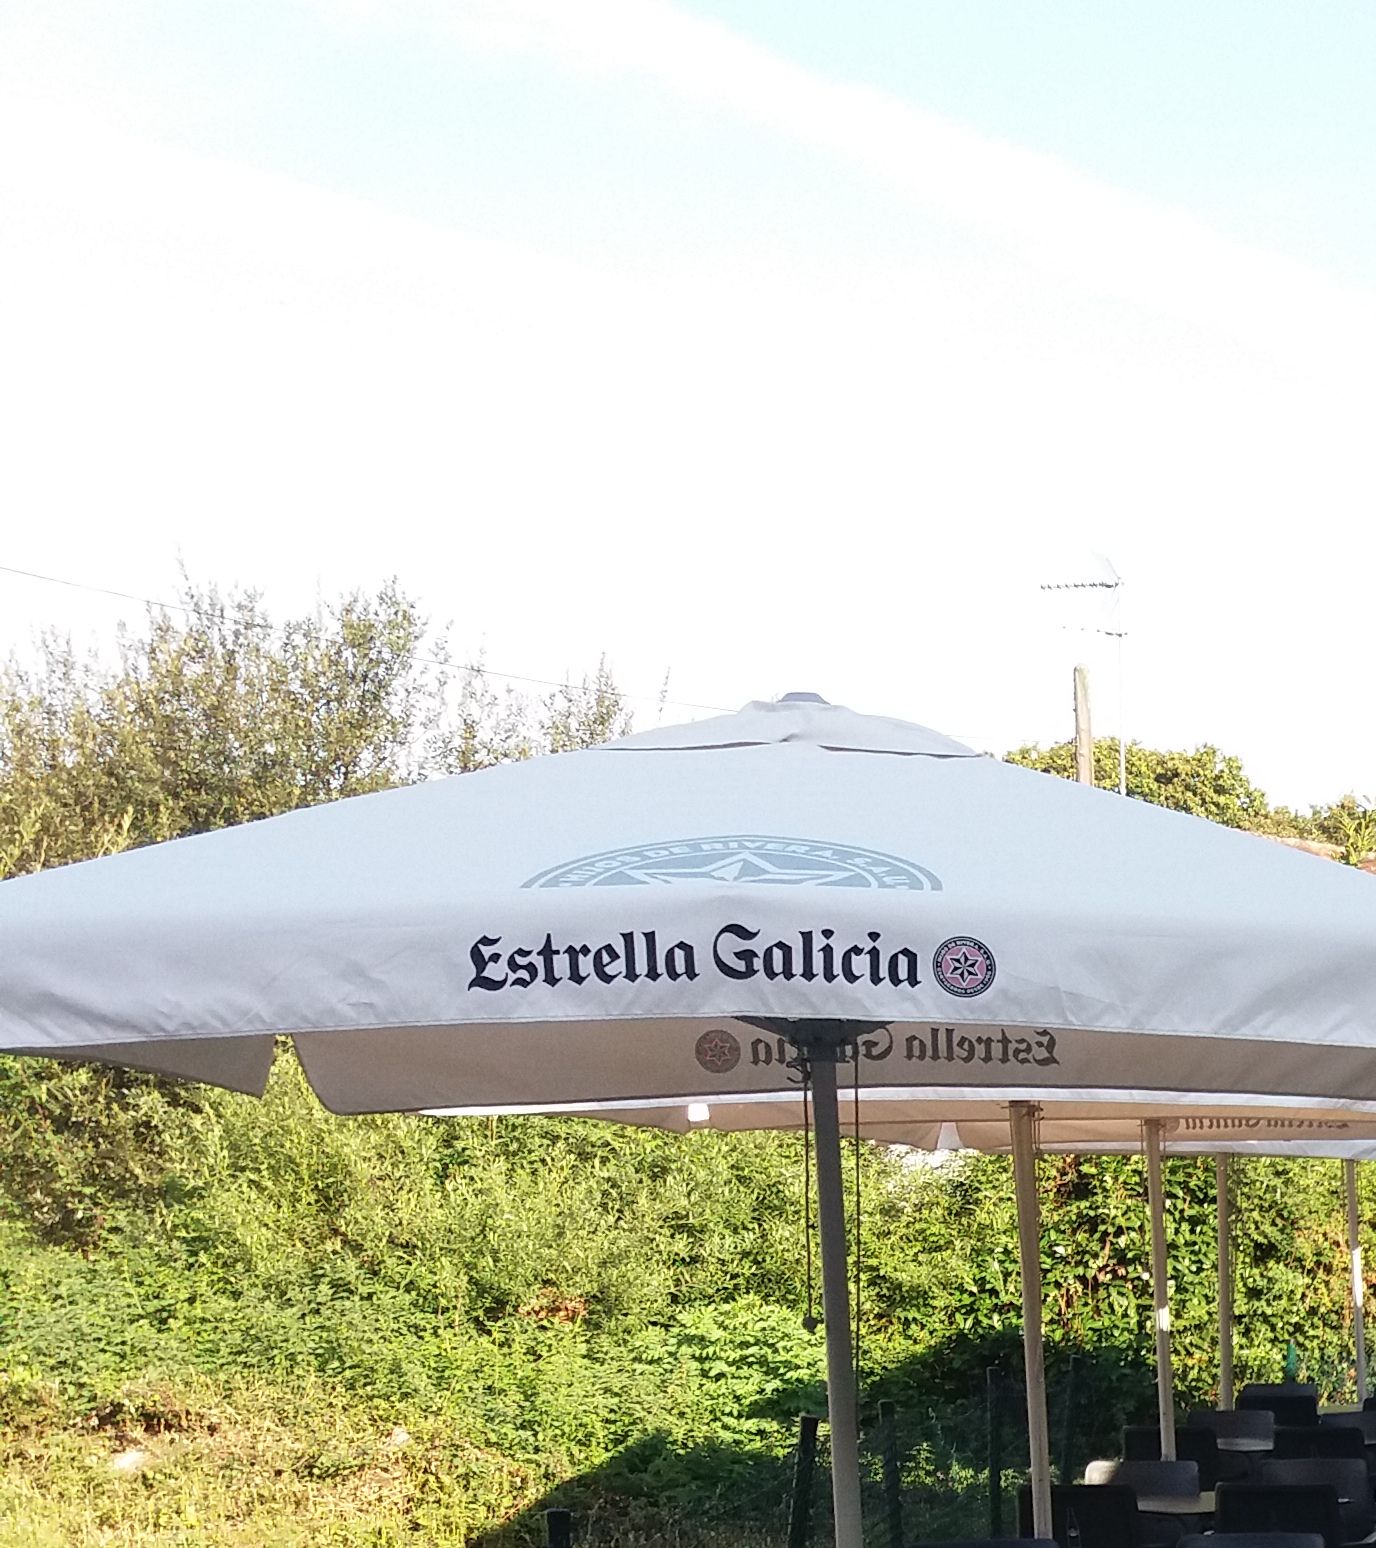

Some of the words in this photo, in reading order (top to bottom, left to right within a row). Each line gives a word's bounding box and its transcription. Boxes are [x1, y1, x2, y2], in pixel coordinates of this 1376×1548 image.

[559, 855, 642, 882] HIJOS
[643, 846, 693, 858] DE
[466, 930, 701, 992] Estrella
[712, 923, 922, 989] Galicia
